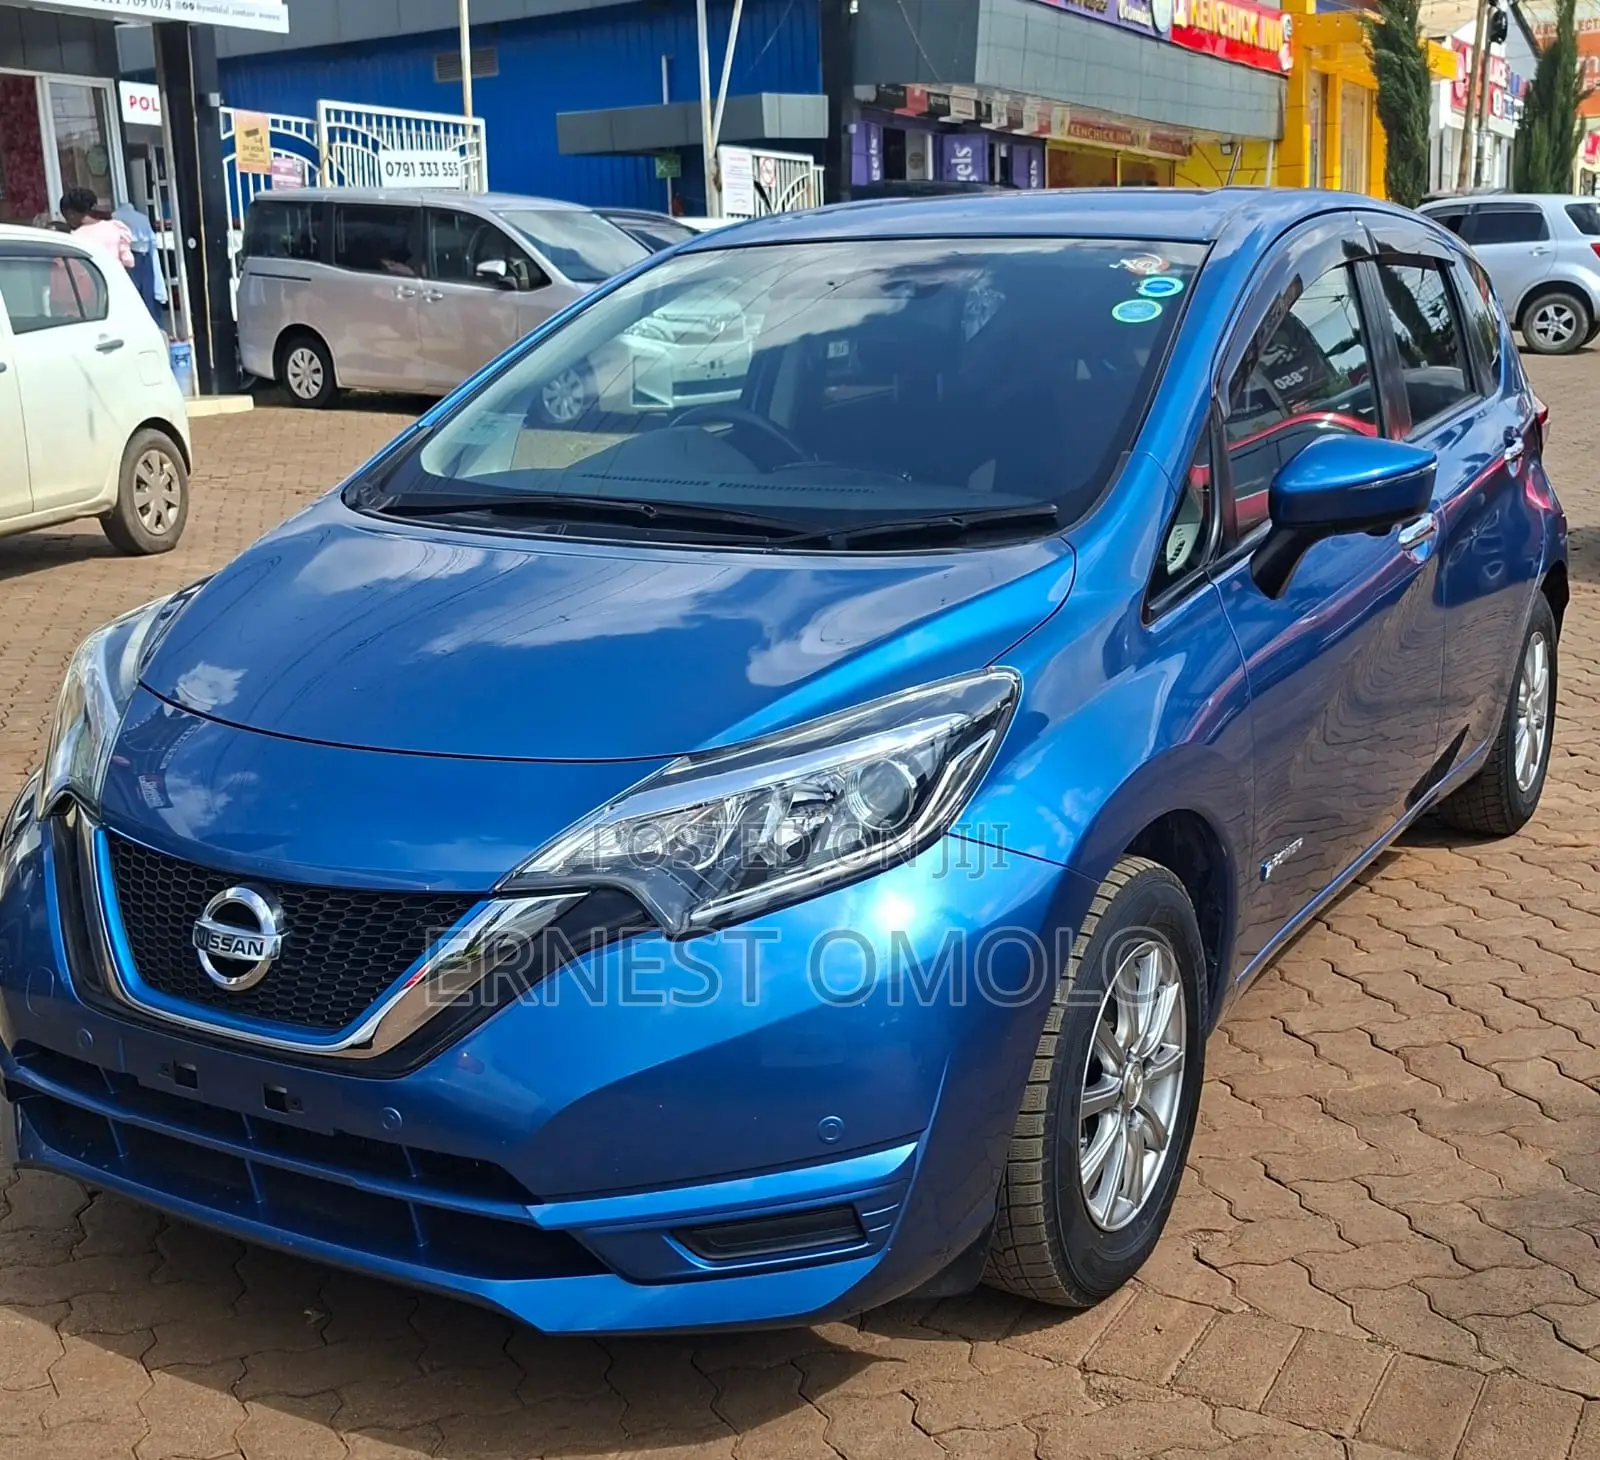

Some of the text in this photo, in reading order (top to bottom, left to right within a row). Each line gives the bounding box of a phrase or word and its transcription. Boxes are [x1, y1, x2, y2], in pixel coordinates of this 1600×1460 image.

[1188, 0, 1282, 52] KENCHICK INN
[129, 95, 161, 112] POL
[1070, 124, 1115, 142] KENCHICK
[386, 161, 460, 177] 0791 333 555
[195, 927, 265, 957] NISSAN
